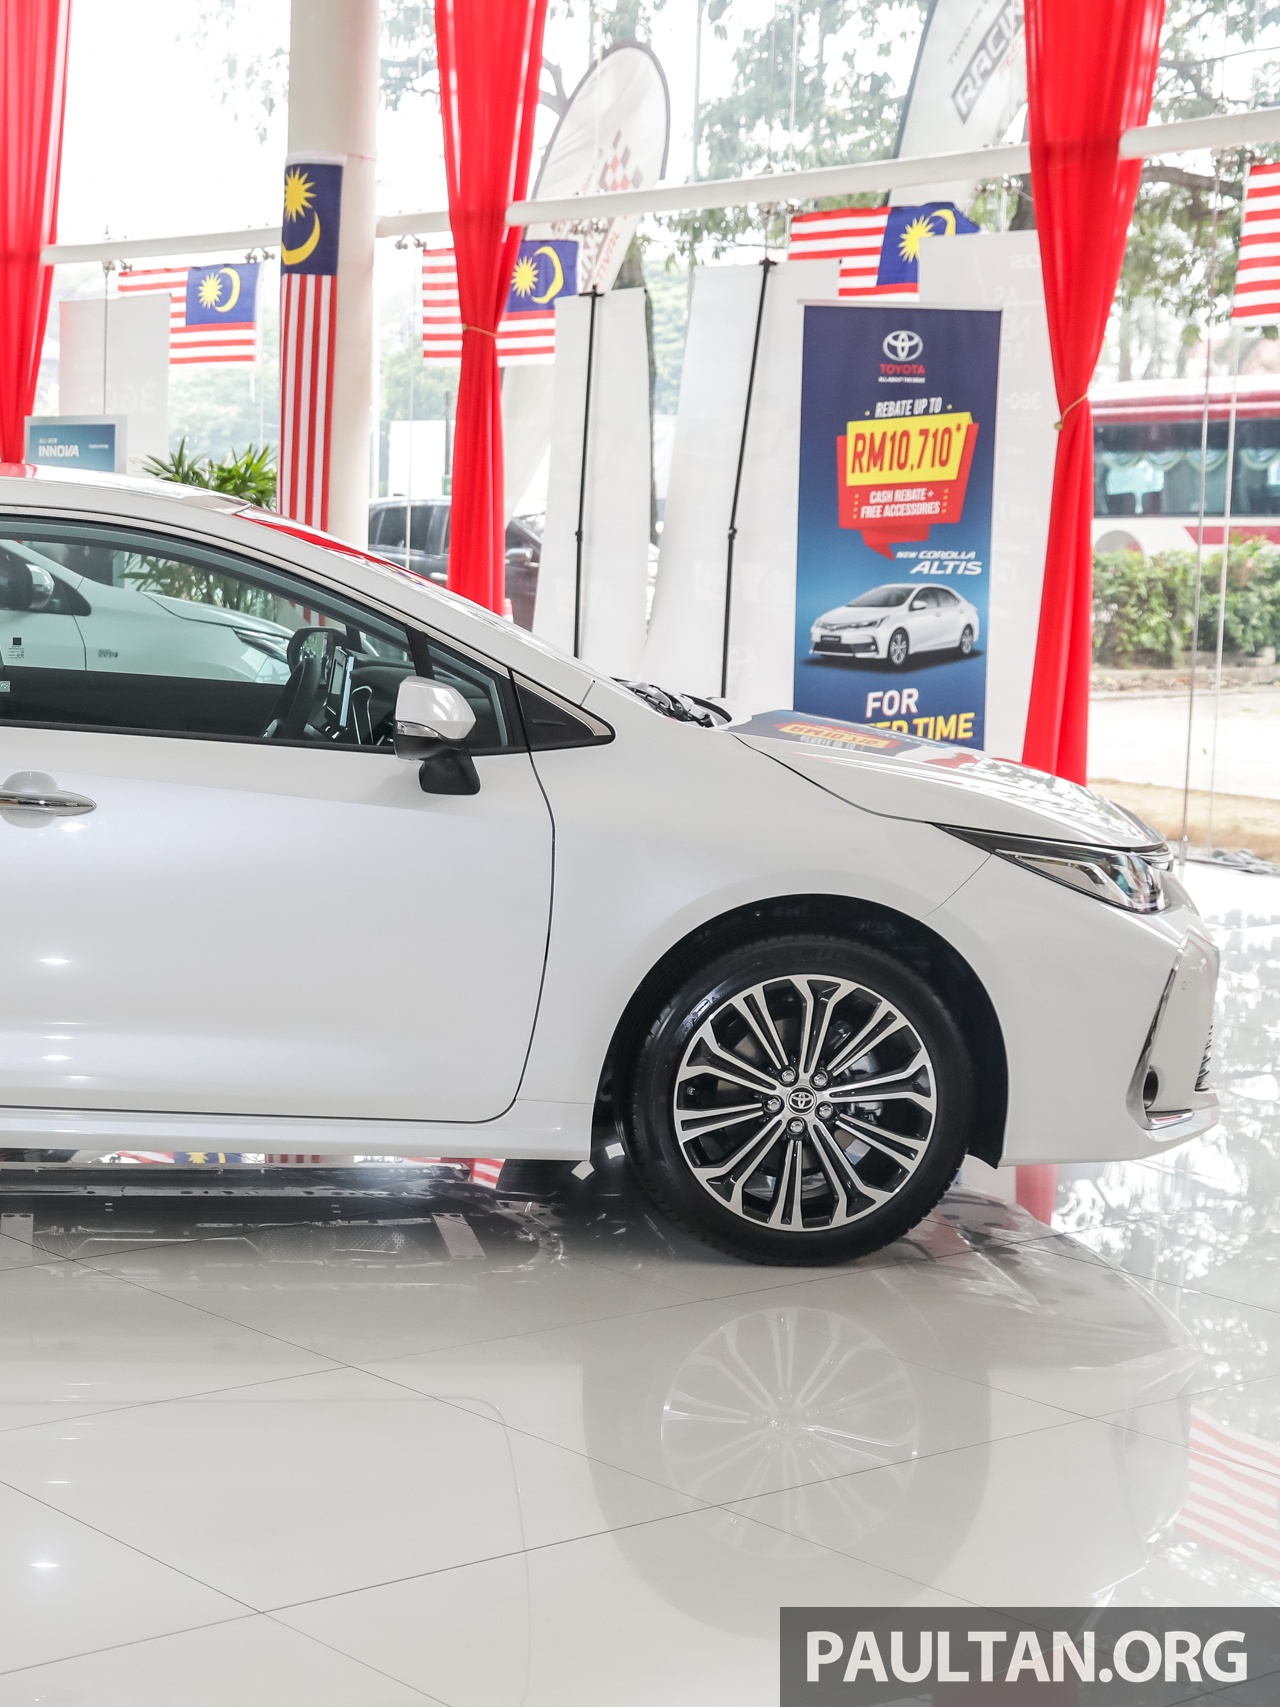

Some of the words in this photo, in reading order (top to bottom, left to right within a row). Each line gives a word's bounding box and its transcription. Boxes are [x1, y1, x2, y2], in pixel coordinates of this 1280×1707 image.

[953, 0, 1024, 117] RACIN
[880, 363, 926, 375] TOYOTA
[874, 399, 913, 419] REBATE
[913, 398, 928, 415] UP
[929, 396, 943, 414] TO
[38, 445, 80, 458] INNOVA
[869, 490, 894, 504] CASH
[894, 488, 927, 503] REBATE
[860, 505, 883, 519] FREE
[883, 501, 941, 517] ACCESSORIES
[918, 550, 976, 560] COROLLA
[909, 560, 983, 576] ALTIS
[865, 687, 920, 719] FOR
[912, 712, 976, 741] TIME
